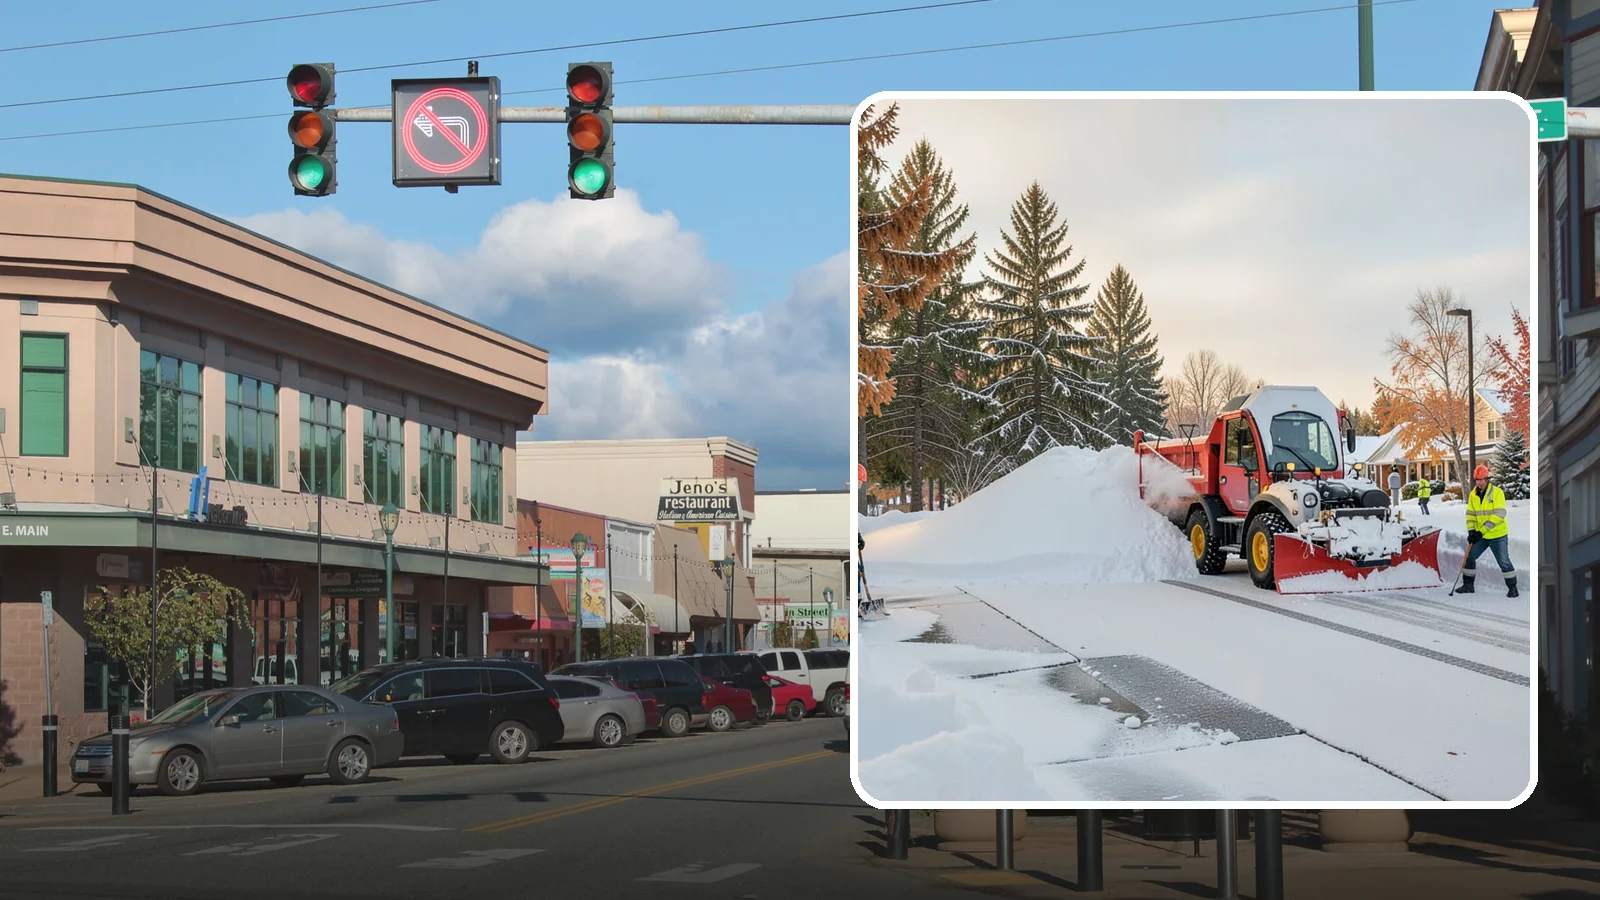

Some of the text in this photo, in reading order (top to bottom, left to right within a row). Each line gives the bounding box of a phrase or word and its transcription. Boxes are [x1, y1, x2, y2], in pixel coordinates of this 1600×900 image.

[670, 480, 727, 494] Jeno's
[665, 496, 731, 509] restaurant
[659, 510, 681, 519] Italian
[686, 510, 714, 519] American
[715, 510, 737, 519] Cuisine
[2, 525, 49, 536] E. MAIN
[797, 607, 829, 617] Street
